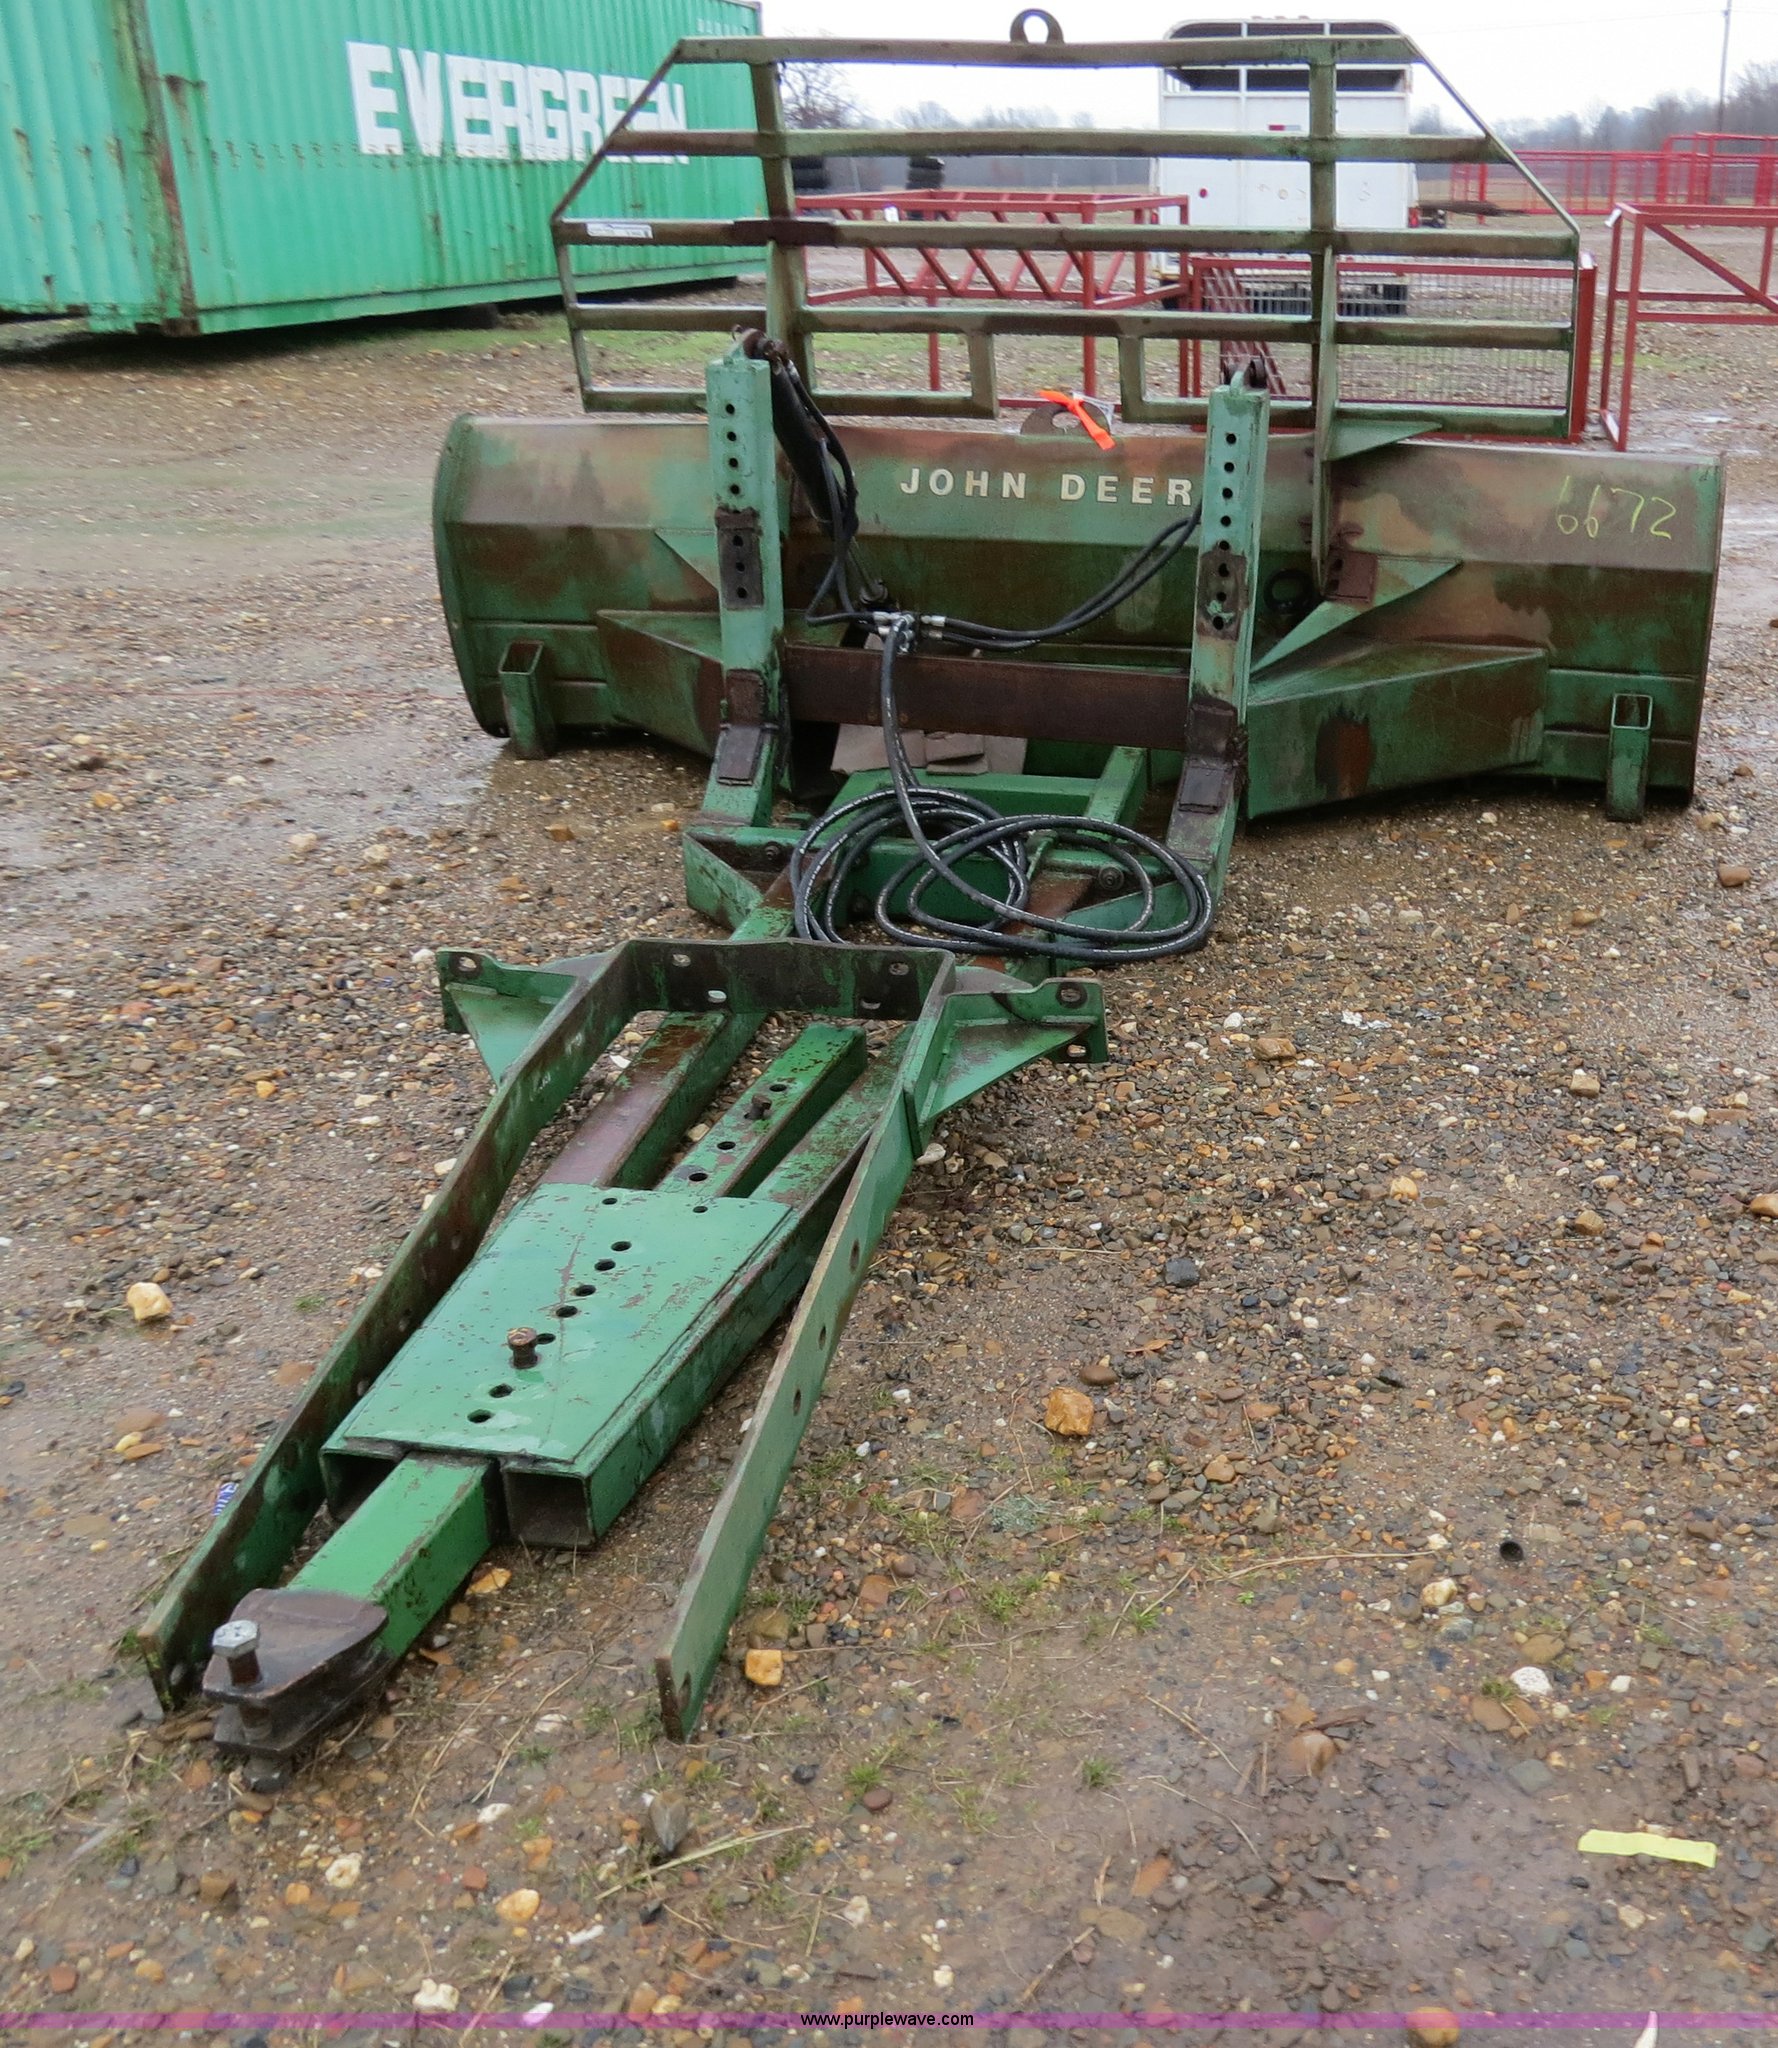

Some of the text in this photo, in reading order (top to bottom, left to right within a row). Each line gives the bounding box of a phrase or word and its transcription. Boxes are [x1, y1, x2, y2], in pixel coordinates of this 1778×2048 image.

[346, 41, 690, 165] EVERGREEN
[900, 468, 1193, 506] JOHN DEER
[1556, 475, 1677, 540] 6672
